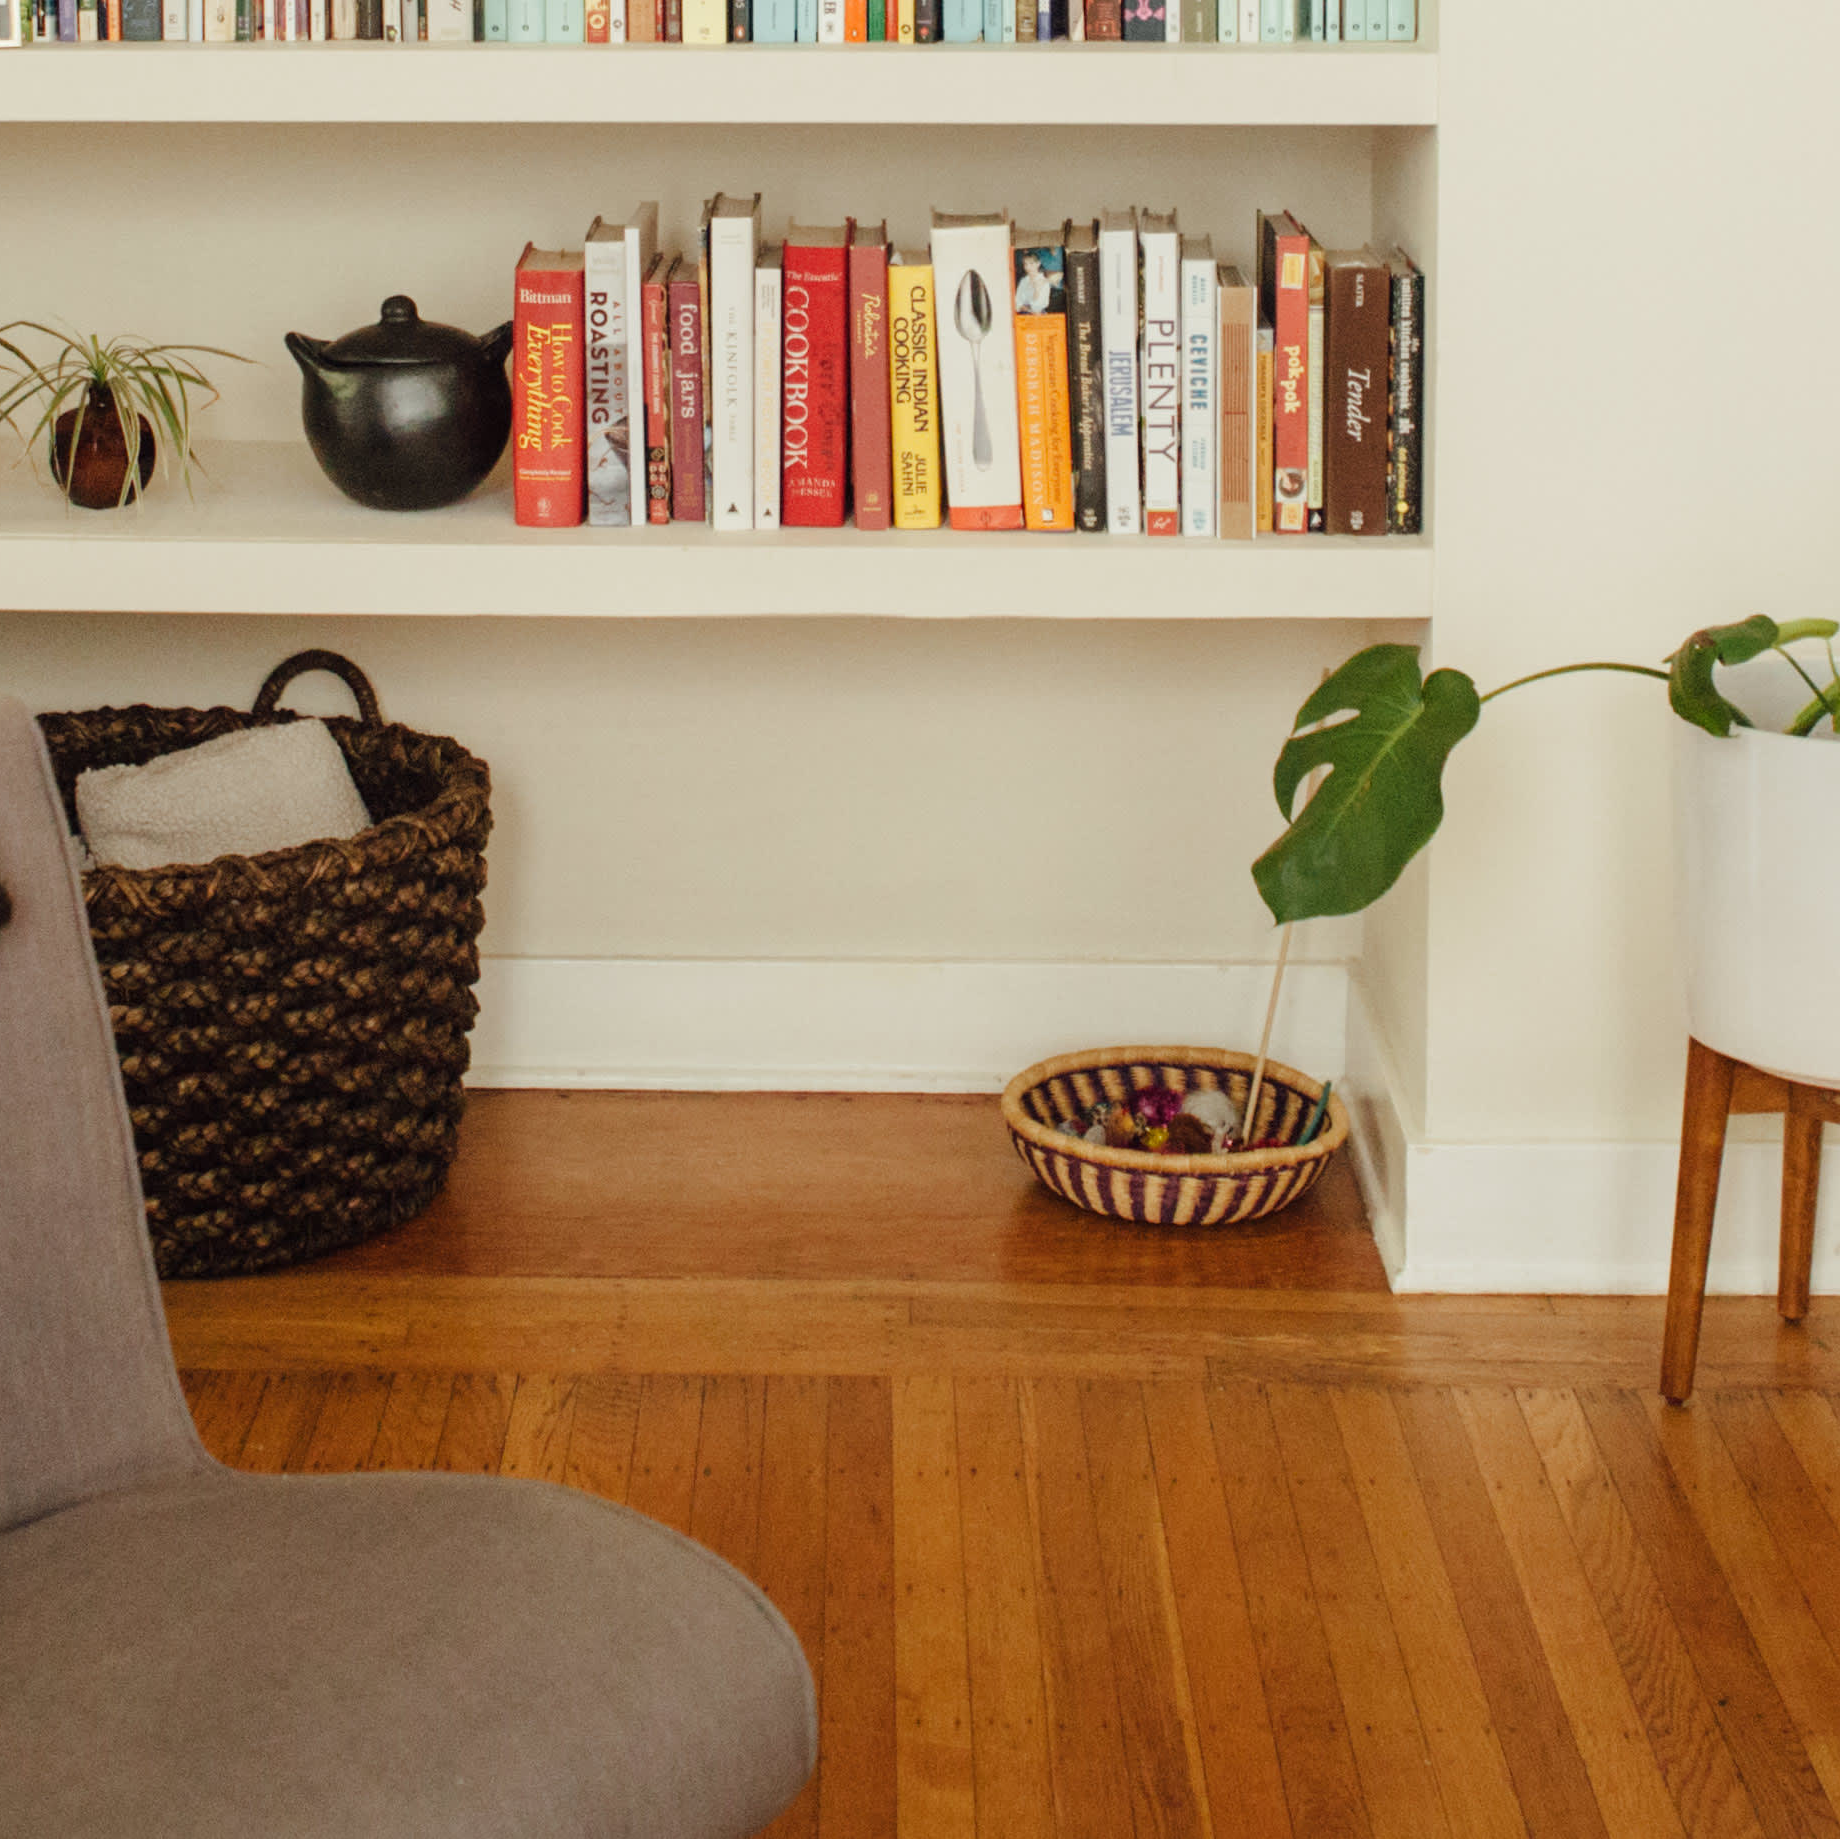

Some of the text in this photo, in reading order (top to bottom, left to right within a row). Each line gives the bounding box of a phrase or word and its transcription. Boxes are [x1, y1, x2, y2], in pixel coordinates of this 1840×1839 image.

[519, 288, 572, 303] Bittman
[861, 294, 880, 360] Roberta's
[1355, 274, 1365, 308] SLATER
[1400, 278, 1414, 360] smitten kitchen
[518, 323, 550, 452] Everything
[551, 323, 574, 449] How to Cook
[591, 291, 609, 424] ROASTING
[613, 301, 623, 415] ALL ABOUT
[675, 303, 699, 419] food jars
[726, 331, 737, 407] KINFOLK
[893, 317, 911, 404] COOKING
[910, 285, 928, 433] CLASSIC INDIAN
[1079, 321, 1094, 470] The Bread Baker's Apprentice
[1107, 350, 1134, 437] JERUSALEM
[1147, 320, 1176, 463] PLENTY
[1189, 334, 1208, 411] CEVICHE
[1281, 345, 1304, 414] pok pok
[1025, 332, 1043, 506] DEBORAH MADISON
[1045, 332, 1064, 504] Vegetarian Cooking for Everyone
[1346, 368, 1371, 442] Tender
[900, 451, 914, 497] SAHNI
[915, 454, 927, 495] JULIE
